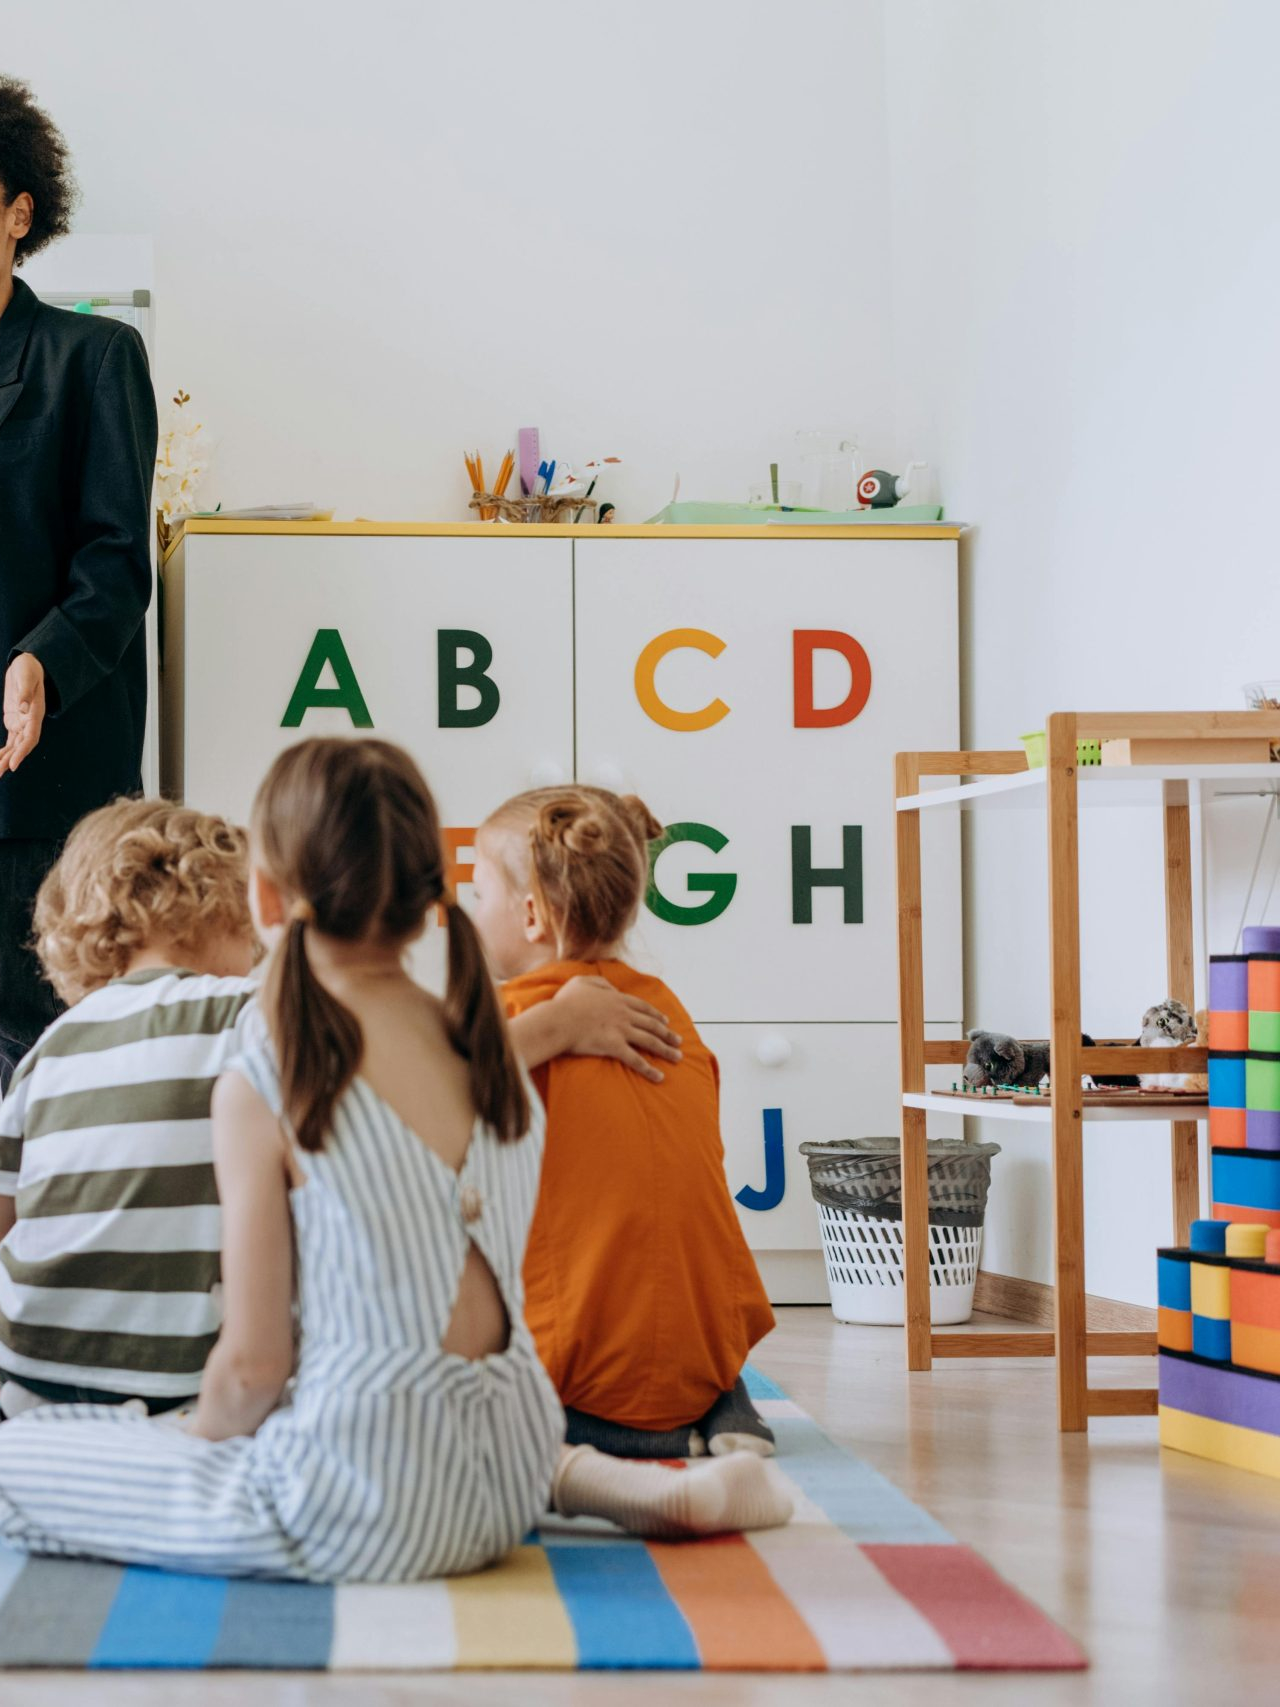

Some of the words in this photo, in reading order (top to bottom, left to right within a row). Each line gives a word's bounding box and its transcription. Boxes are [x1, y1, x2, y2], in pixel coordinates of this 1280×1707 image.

[280, 628, 374, 729] A
[437, 629, 500, 729] B
[634, 628, 731, 732] C
[792, 629, 872, 729] D
[644, 821, 738, 926] G
[791, 824, 864, 924] H
[734, 1108, 786, 1211] J
